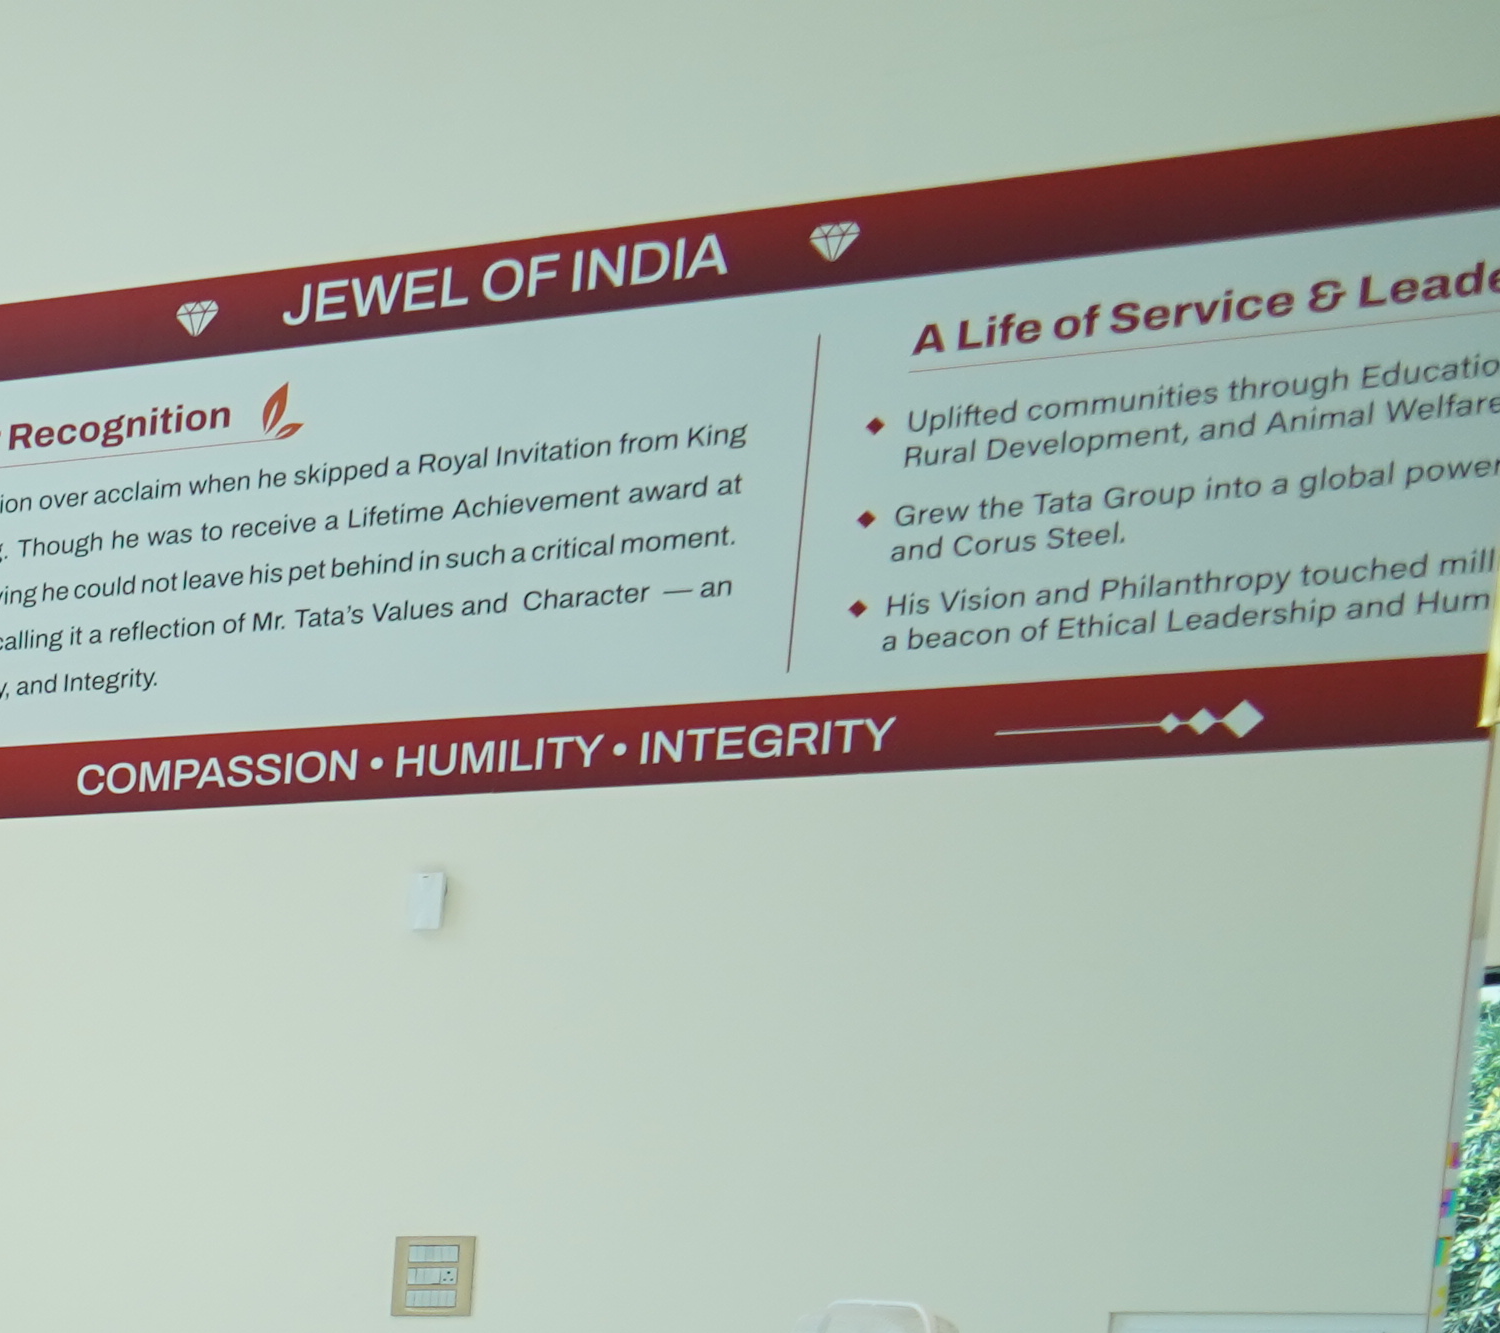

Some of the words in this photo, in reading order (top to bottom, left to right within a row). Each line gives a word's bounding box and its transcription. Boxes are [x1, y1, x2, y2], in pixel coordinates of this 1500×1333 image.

[282, 266, 469, 327] JEWEL
[481, 252, 561, 303] OF
[570, 232, 729, 293] INDIA
[911, 322, 946, 356] A
[956, 314, 1043, 352] Life
[1053, 304, 1102, 341] of
[1109, 289, 1295, 334] Service
[1308, 279, 1346, 313] &
[7, 402, 232, 451] Recognition
[902, 437, 977, 469] Rural
[985, 420, 1189, 461] Development,
[1198, 410, 1257, 442] and
[1263, 399, 1375, 435] Animal
[906, 398, 1018, 437] Uplifted
[1025, 382, 1219, 422] communities
[1227, 366, 1350, 402] through
[38, 489, 89, 511] over
[92, 477, 182, 506] acclaim
[187, 472, 251, 496] when
[256, 467, 288, 490] he
[292, 455, 390, 488] skipped
[394, 458, 411, 477] a
[417, 445, 489, 476] Royal
[495, 436, 612, 467] Invitation
[618, 431, 679, 455] from
[686, 422, 748, 450] King
[893, 503, 970, 528] Grew
[977, 494, 1025, 521] the
[1032, 489, 1093, 515] Tata
[1102, 484, 1196, 512] Group
[1204, 475, 1262, 501] into
[1270, 476, 1289, 496] a
[1298, 459, 1395, 500] global
[16, 530, 104, 559] Though
[110, 528, 140, 550] he
[146, 527, 193, 547] was
[199, 521, 224, 543] to
[230, 512, 317, 540] receive
[323, 513, 340, 532] a
[347, 502, 445, 530] Lifetime
[450, 484, 621, 521] Achievement
[627, 474, 709, 505] award
[716, 472, 743, 497] at
[889, 534, 944, 563] and
[951, 533, 1037, 558] Corus
[41, 581, 70, 603] he
[72, 573, 137, 600] could
[140, 571, 179, 595] not
[181, 569, 245, 591] leave
[248, 562, 284, 586] his
[287, 558, 327, 587] pet
[330, 549, 414, 579] behind
[418, 549, 441, 572] in
[444, 542, 506, 570] such
[509, 545, 527, 564] a
[530, 532, 616, 563] critical
[619, 524, 736, 555] moment.
[885, 591, 930, 617] His
[939, 585, 1026, 614] Vision
[1034, 577, 1091, 607] and
[1099, 568, 1292, 602] Philanthropy
[1299, 551, 1429, 587] touched
[68, 624, 83, 646] it
[87, 627, 103, 645] a
[108, 616, 216, 643] reflection
[221, 611, 247, 635] of
[251, 610, 286, 633] Mr.
[371, 598, 454, 623] Values
[460, 591, 509, 617] and
[522, 583, 651, 612] Character
[698, 578, 733, 599] an
[880, 634, 898, 653] a
[906, 625, 1011, 651] beacon
[1019, 616, 1050, 643] of
[1056, 608, 1157, 641] Ethical
[1165, 597, 1337, 633] Leadership
[1344, 590, 1406, 621] and
[15, 672, 58, 697] and
[62, 666, 158, 695] Integrity.
[75, 748, 360, 797] COMPASSION
[394, 734, 608, 780] HUMILITY
[638, 716, 898, 766] INTEGRITY
